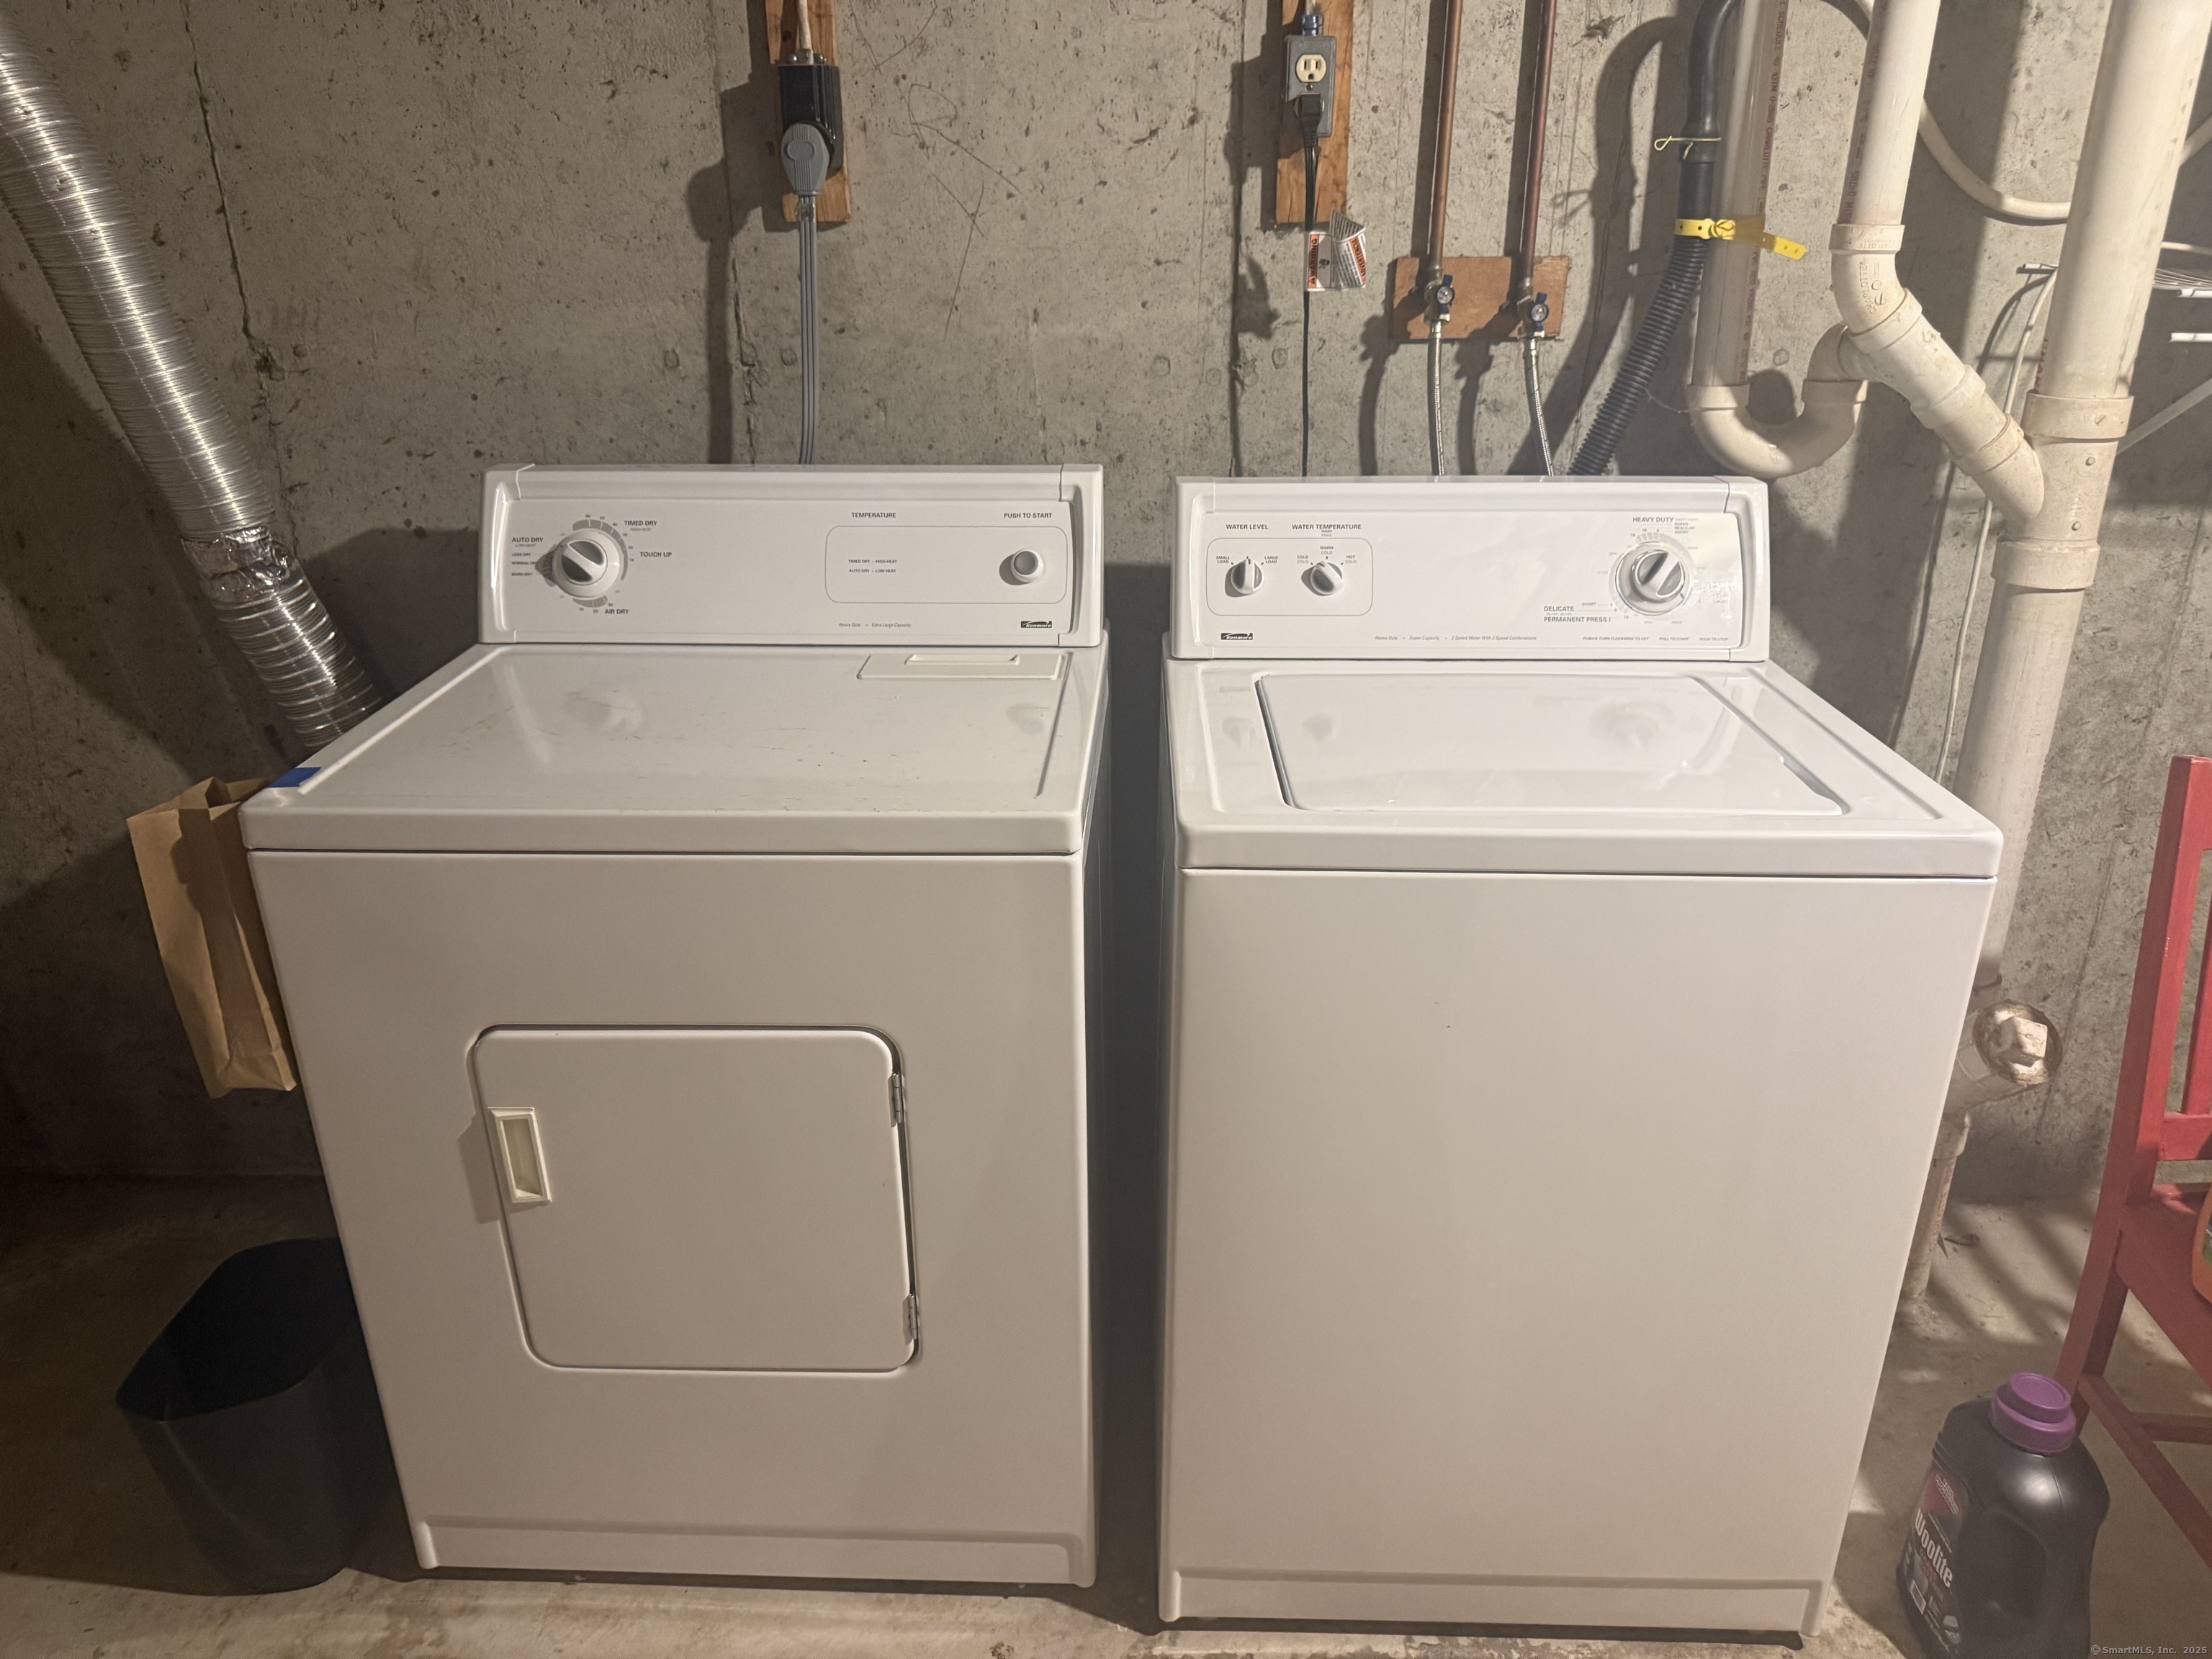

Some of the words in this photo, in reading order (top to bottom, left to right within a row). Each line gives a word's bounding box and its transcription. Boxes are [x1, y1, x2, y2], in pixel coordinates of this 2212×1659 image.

[1761, 127, 1773, 171] CHARLOTTE
[1309, 238, 1318, 274] WARNING
[1915, 1508, 1953, 1588] Woolite
